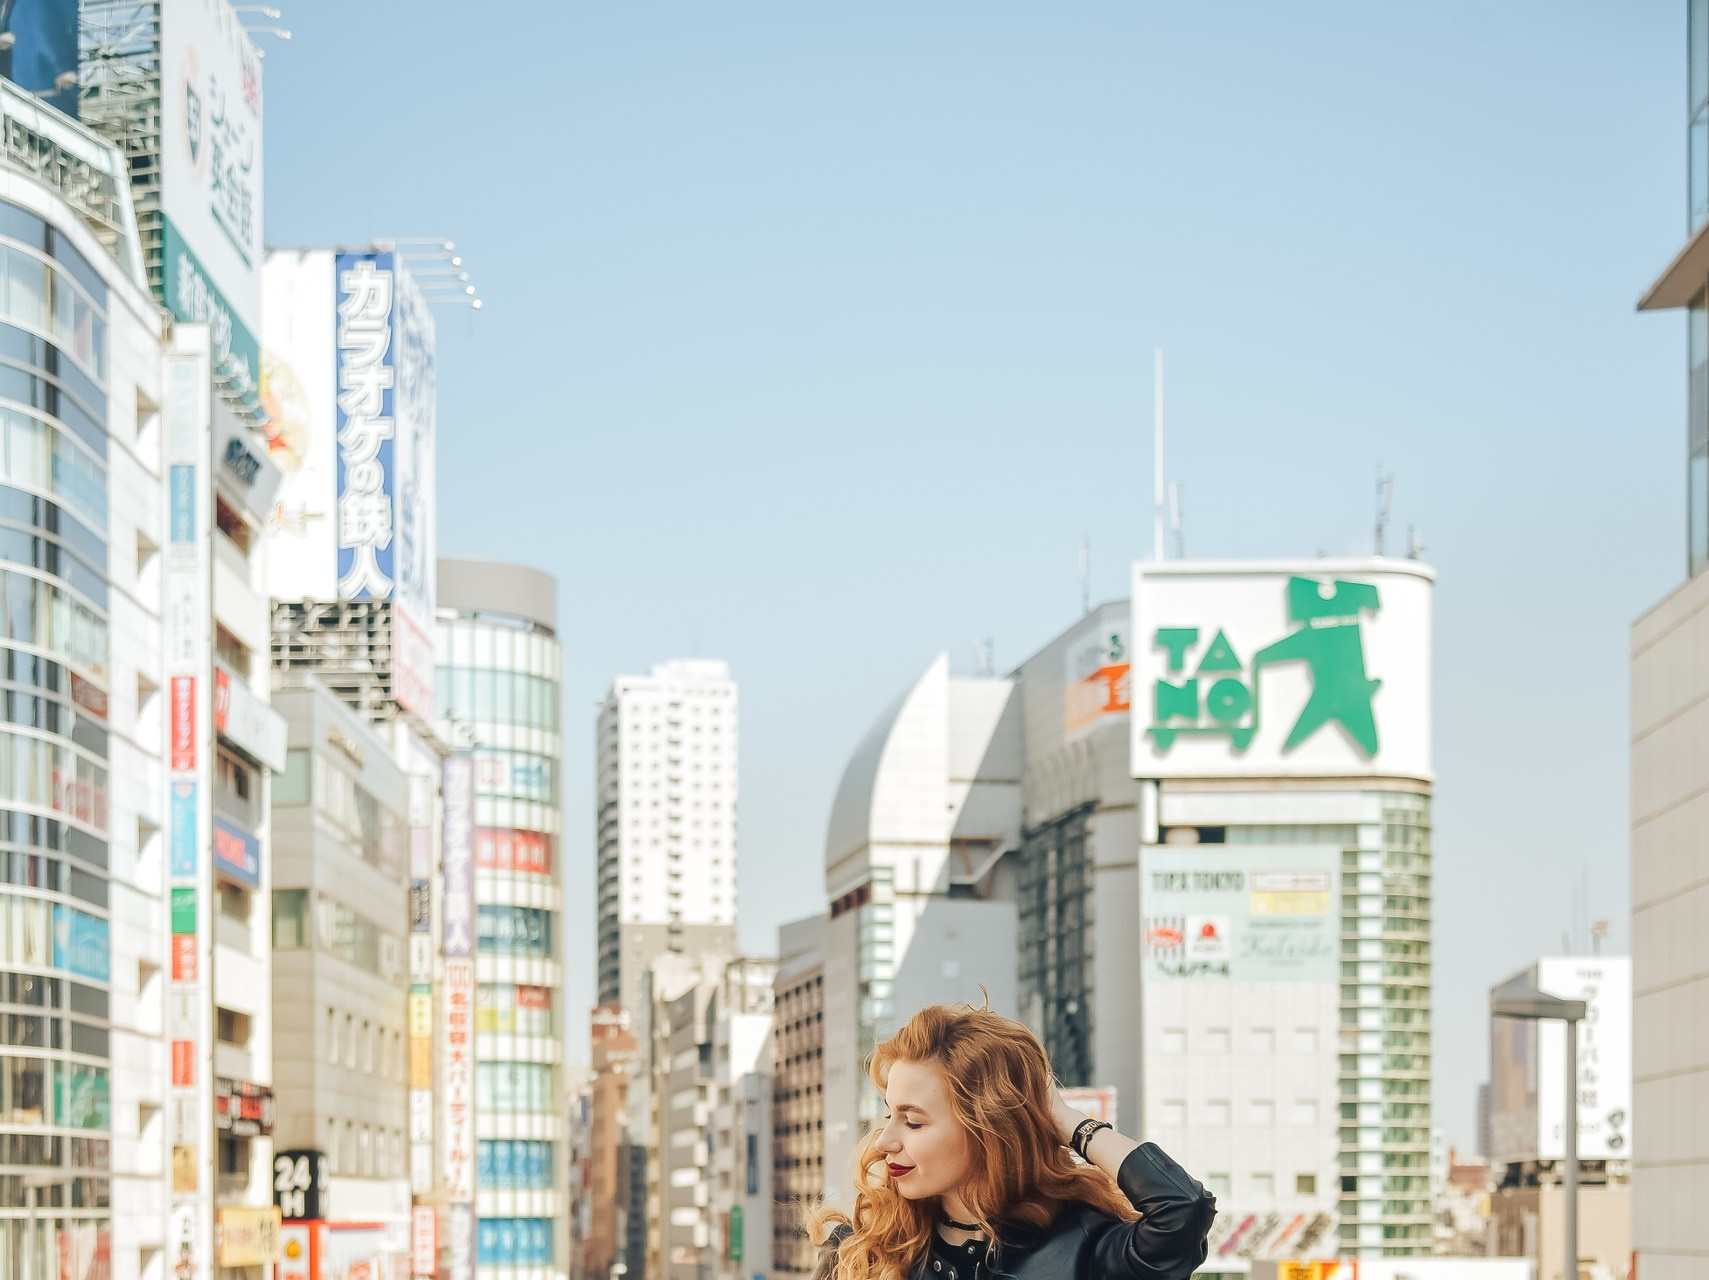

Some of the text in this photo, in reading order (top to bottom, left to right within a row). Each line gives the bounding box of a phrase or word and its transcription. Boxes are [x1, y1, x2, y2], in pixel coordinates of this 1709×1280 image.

[338, 260, 394, 599] カラオケの鉄人
[274, 1155, 312, 1191] 24
[281, 1190, 305, 1217] H
